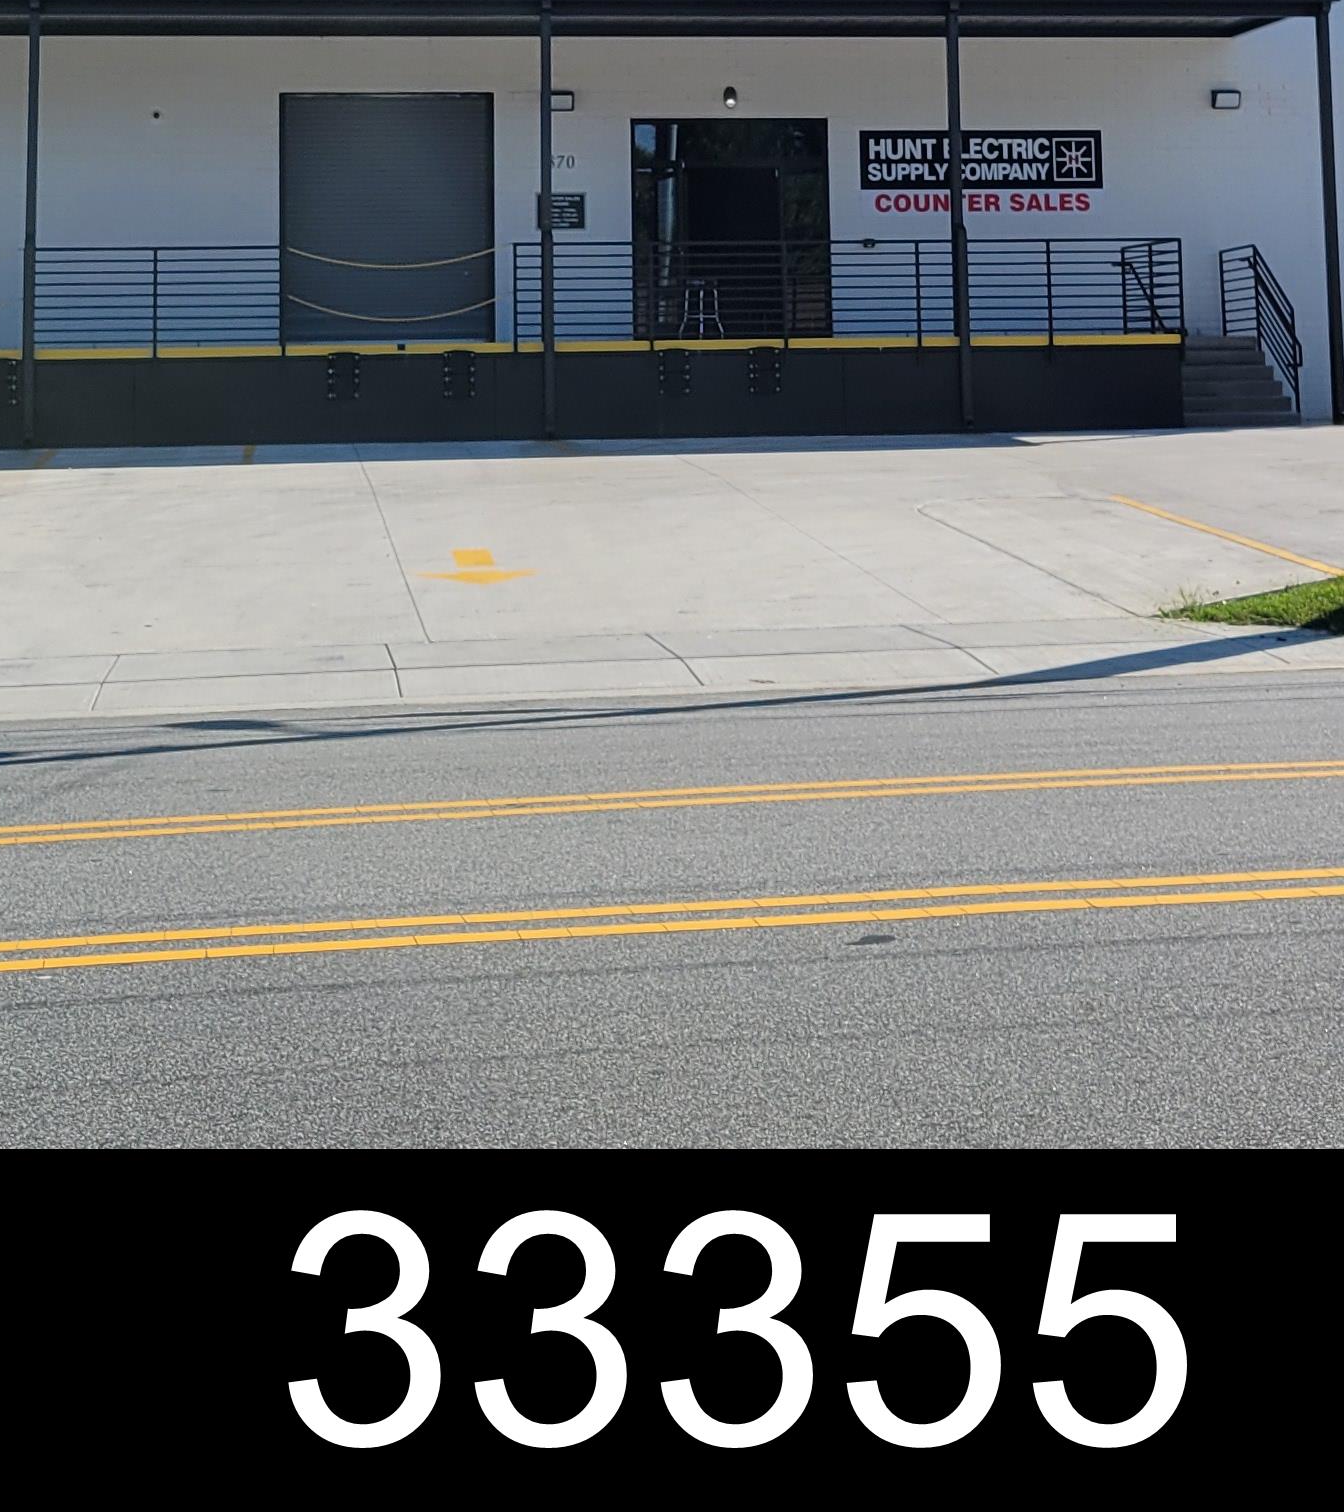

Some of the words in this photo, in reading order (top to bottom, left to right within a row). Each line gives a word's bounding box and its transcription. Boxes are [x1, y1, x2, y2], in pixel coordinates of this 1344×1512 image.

[868, 138, 937, 160] HUNT
[943, 137, 1050, 160] EECTRIC
[551, 155, 575, 169] 70
[867, 163, 949, 181] SUPPLY
[874, 193, 1001, 213] COUNER
[1009, 193, 1091, 212] SALES
